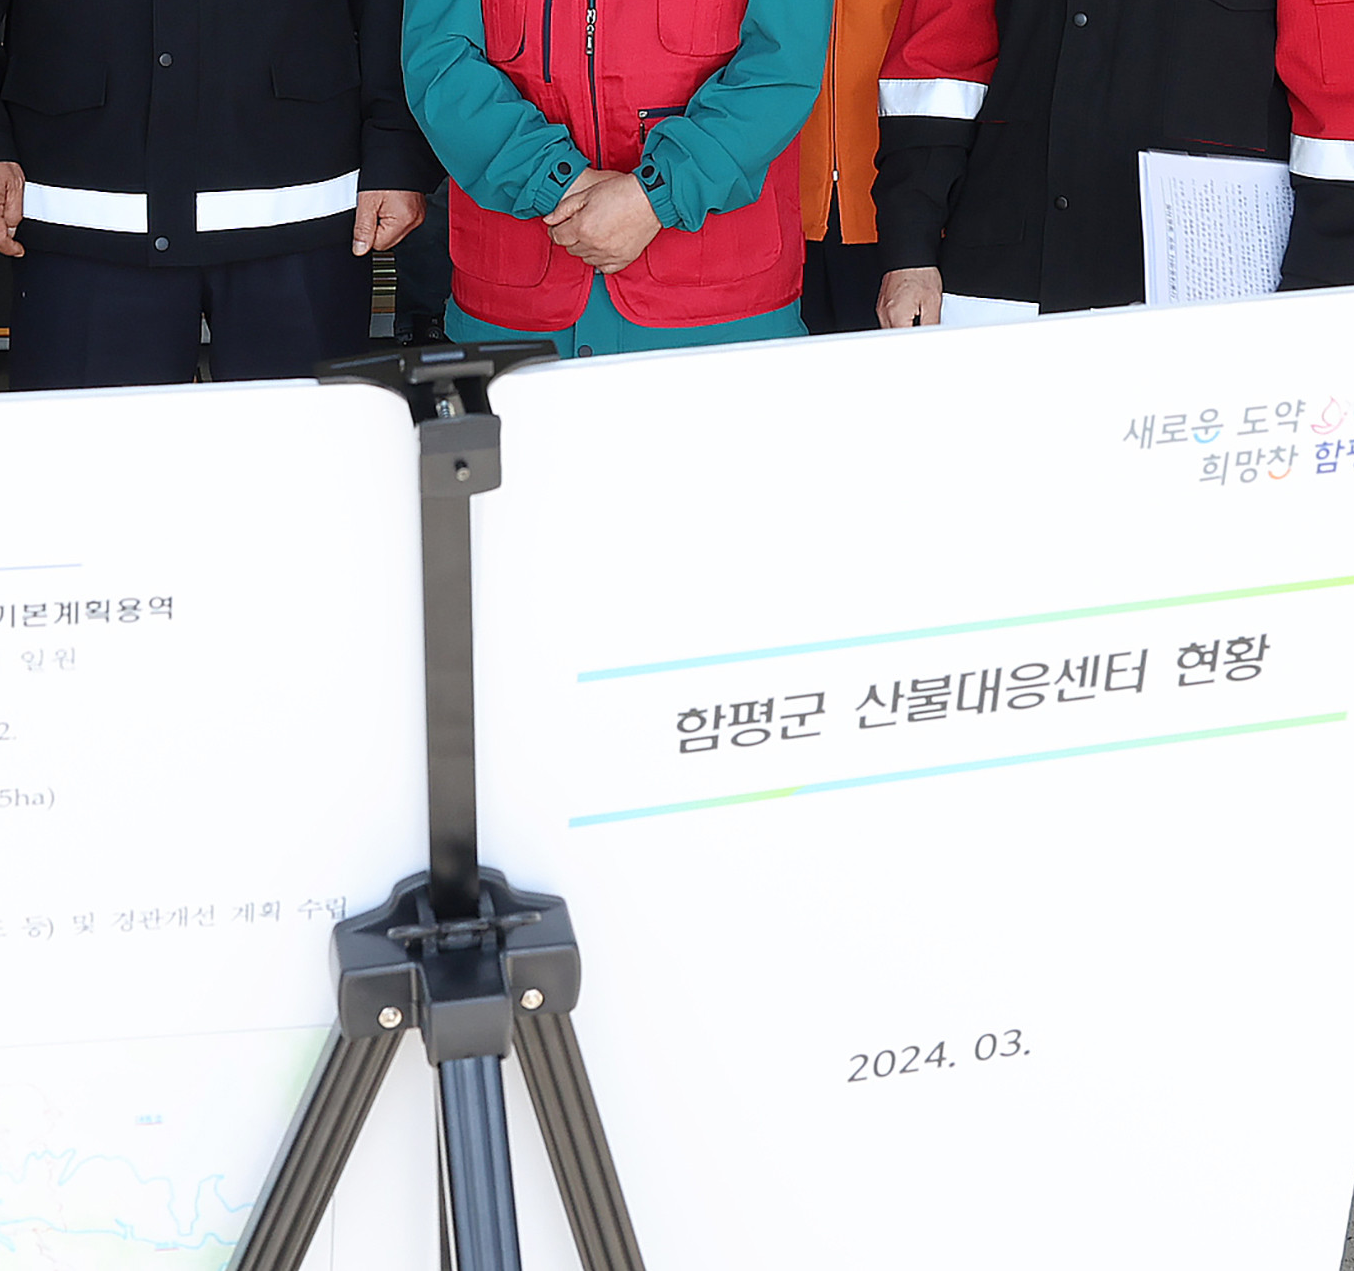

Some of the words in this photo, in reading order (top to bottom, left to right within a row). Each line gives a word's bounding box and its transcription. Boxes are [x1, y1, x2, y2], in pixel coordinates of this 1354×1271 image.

[1123, 407, 1223, 449] 새로운
[1236, 398, 1306, 438] 도약
[1199, 444, 1299, 486] 희망찬
[21, 646, 77, 673] 일원
[677, 690, 826, 756] 함평군
[855, 648, 1150, 730] 산불대응센터
[1175, 632, 1271, 688] 현황
[73, 912, 95, 934] 및
[111, 905, 215, 931] 경관개선
[232, 900, 280, 923] 계획
[847, 1040, 956, 1082] 2024.
[973, 1027, 1033, 1063] 03.
